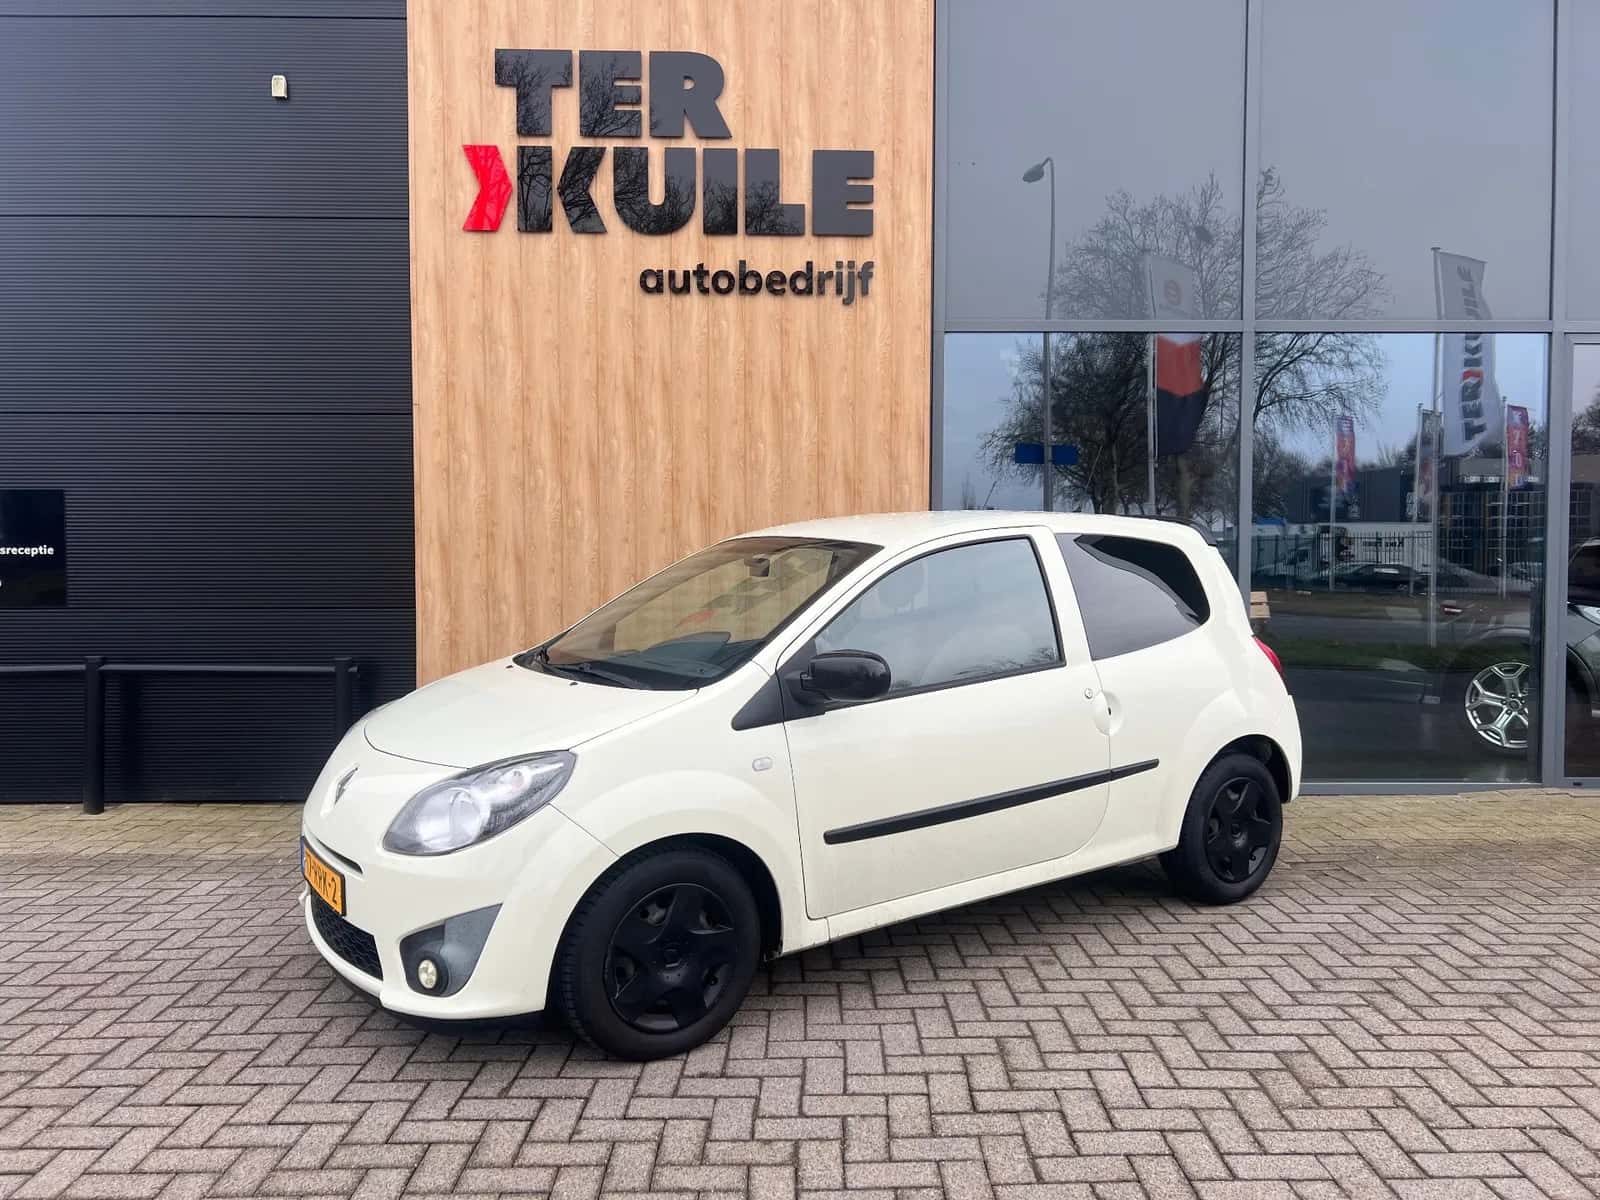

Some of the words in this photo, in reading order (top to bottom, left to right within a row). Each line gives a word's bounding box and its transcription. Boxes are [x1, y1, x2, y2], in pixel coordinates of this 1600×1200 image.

[495, 48, 732, 139] TER
[516, 145, 875, 237] KUILE
[639, 260, 875, 305] autobedrijf
